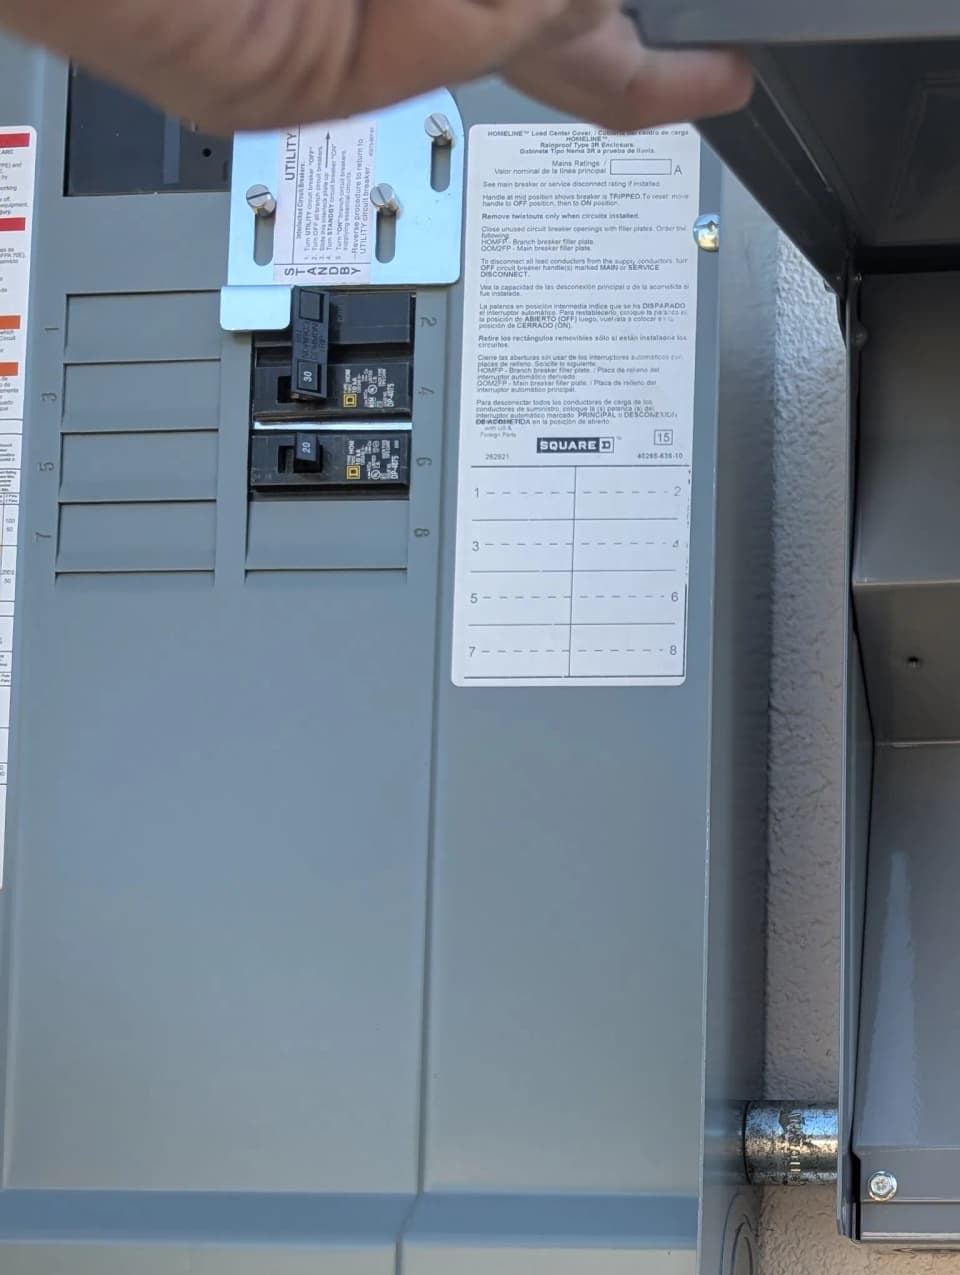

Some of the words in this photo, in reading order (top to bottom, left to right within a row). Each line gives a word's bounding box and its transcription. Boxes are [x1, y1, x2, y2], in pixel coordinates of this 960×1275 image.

[285, 132, 296, 180] UTILITY
[674, 165, 682, 174] A
[354, 181, 362, 220] procedure
[361, 198, 369, 221] circuit
[284, 266, 360, 276] STANDBY
[304, 371, 312, 382] 30
[658, 432, 670, 442] 15
[302, 442, 310, 453] 20
[540, 441, 596, 450] SQUARE
[474, 488, 480, 497] 1
[674, 487, 681, 496] 2
[472, 541, 480, 551] 3
[470, 593, 478, 604] 5
[671, 592, 679, 602] 6
[469, 646, 476, 657] 7
[669, 645, 677, 655] 8
